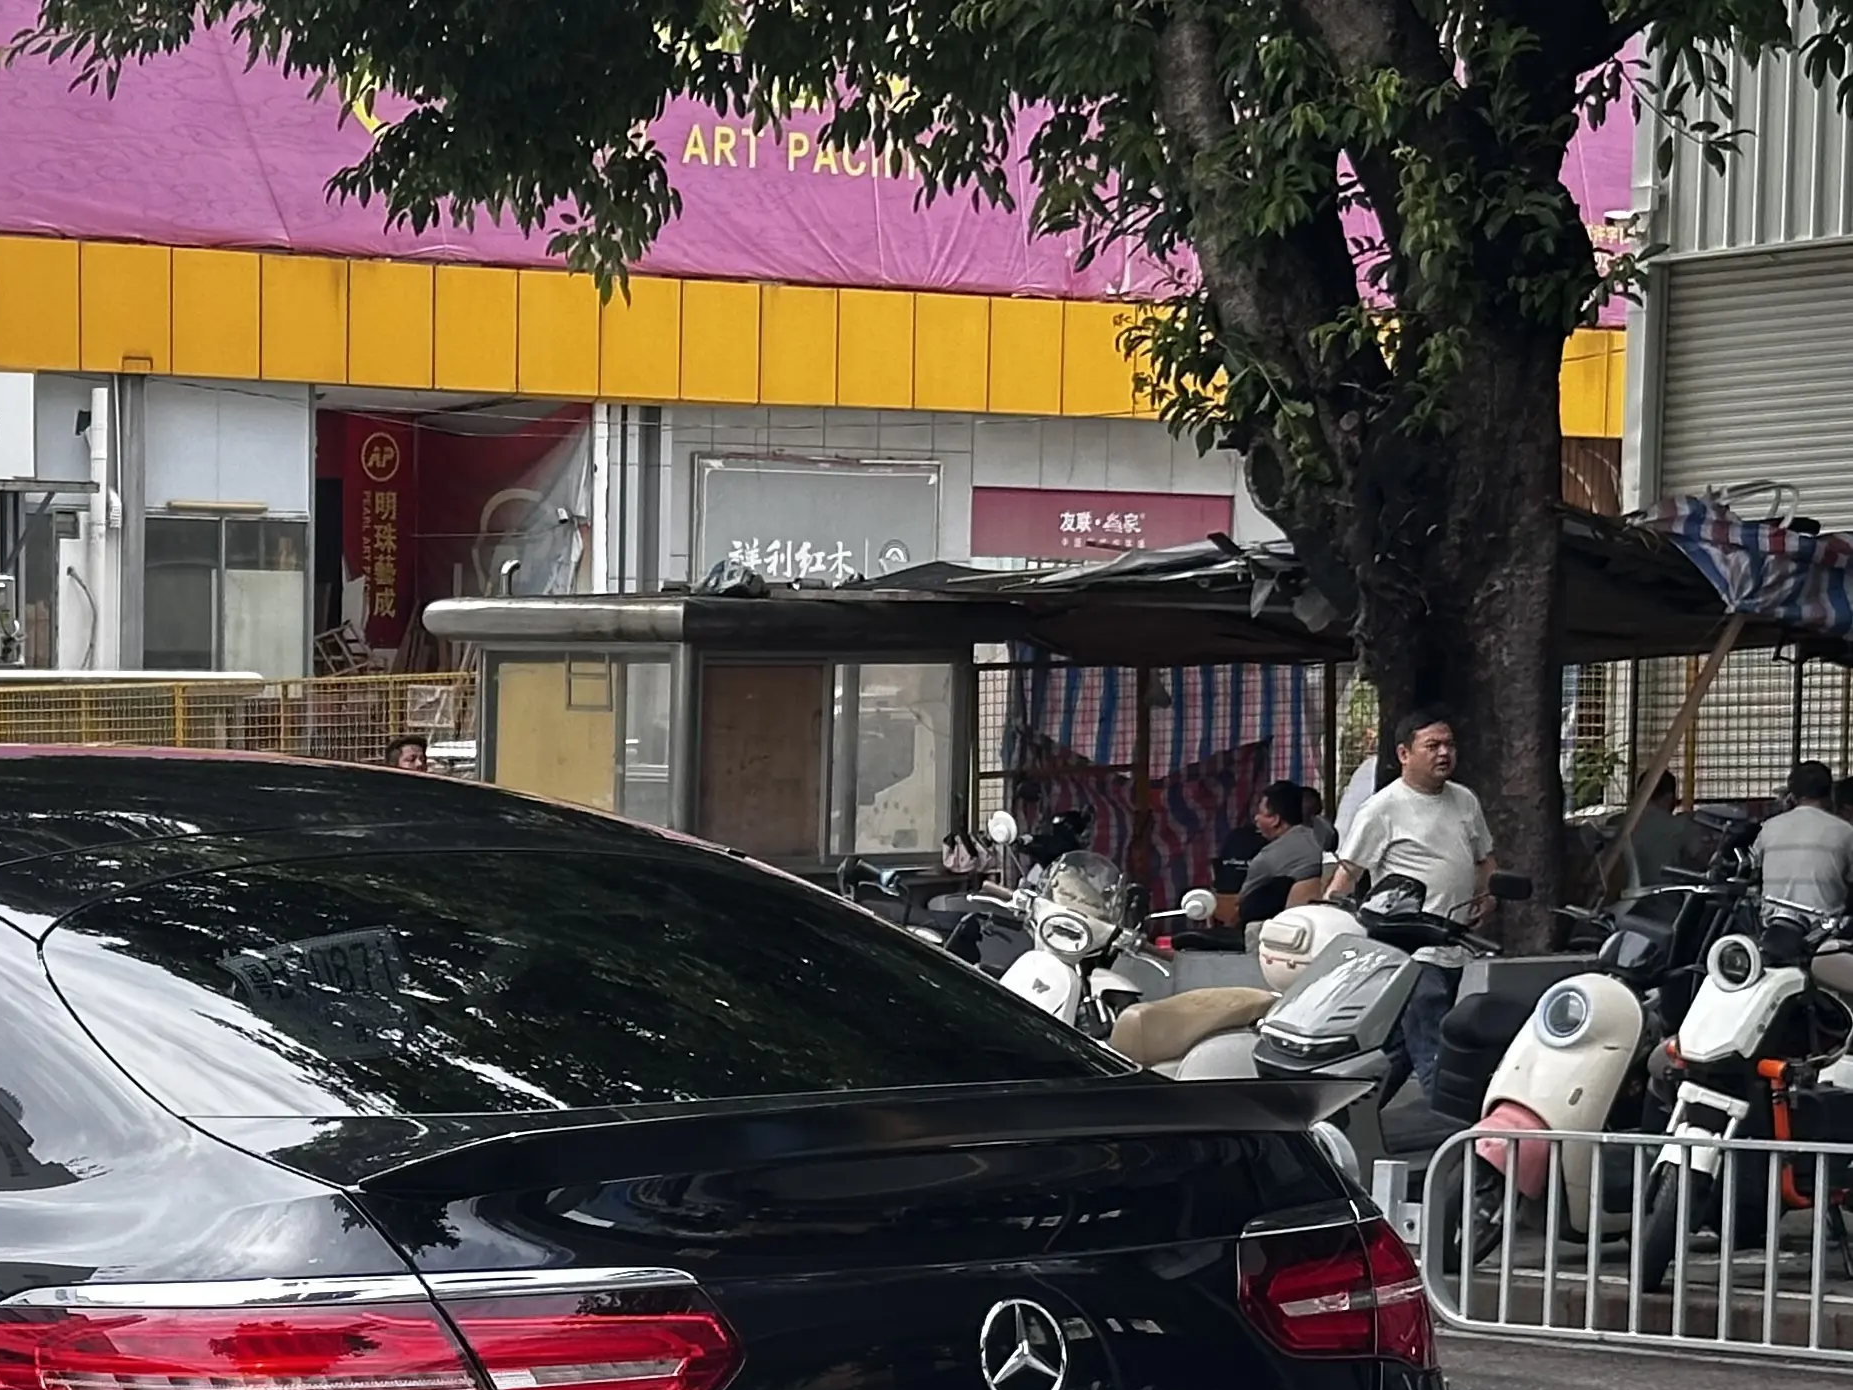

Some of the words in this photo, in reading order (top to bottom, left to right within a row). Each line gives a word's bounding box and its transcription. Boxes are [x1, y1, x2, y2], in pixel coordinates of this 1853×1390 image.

[682, 122, 765, 169] ART
[372, 491, 398, 618] 明珠藝成
